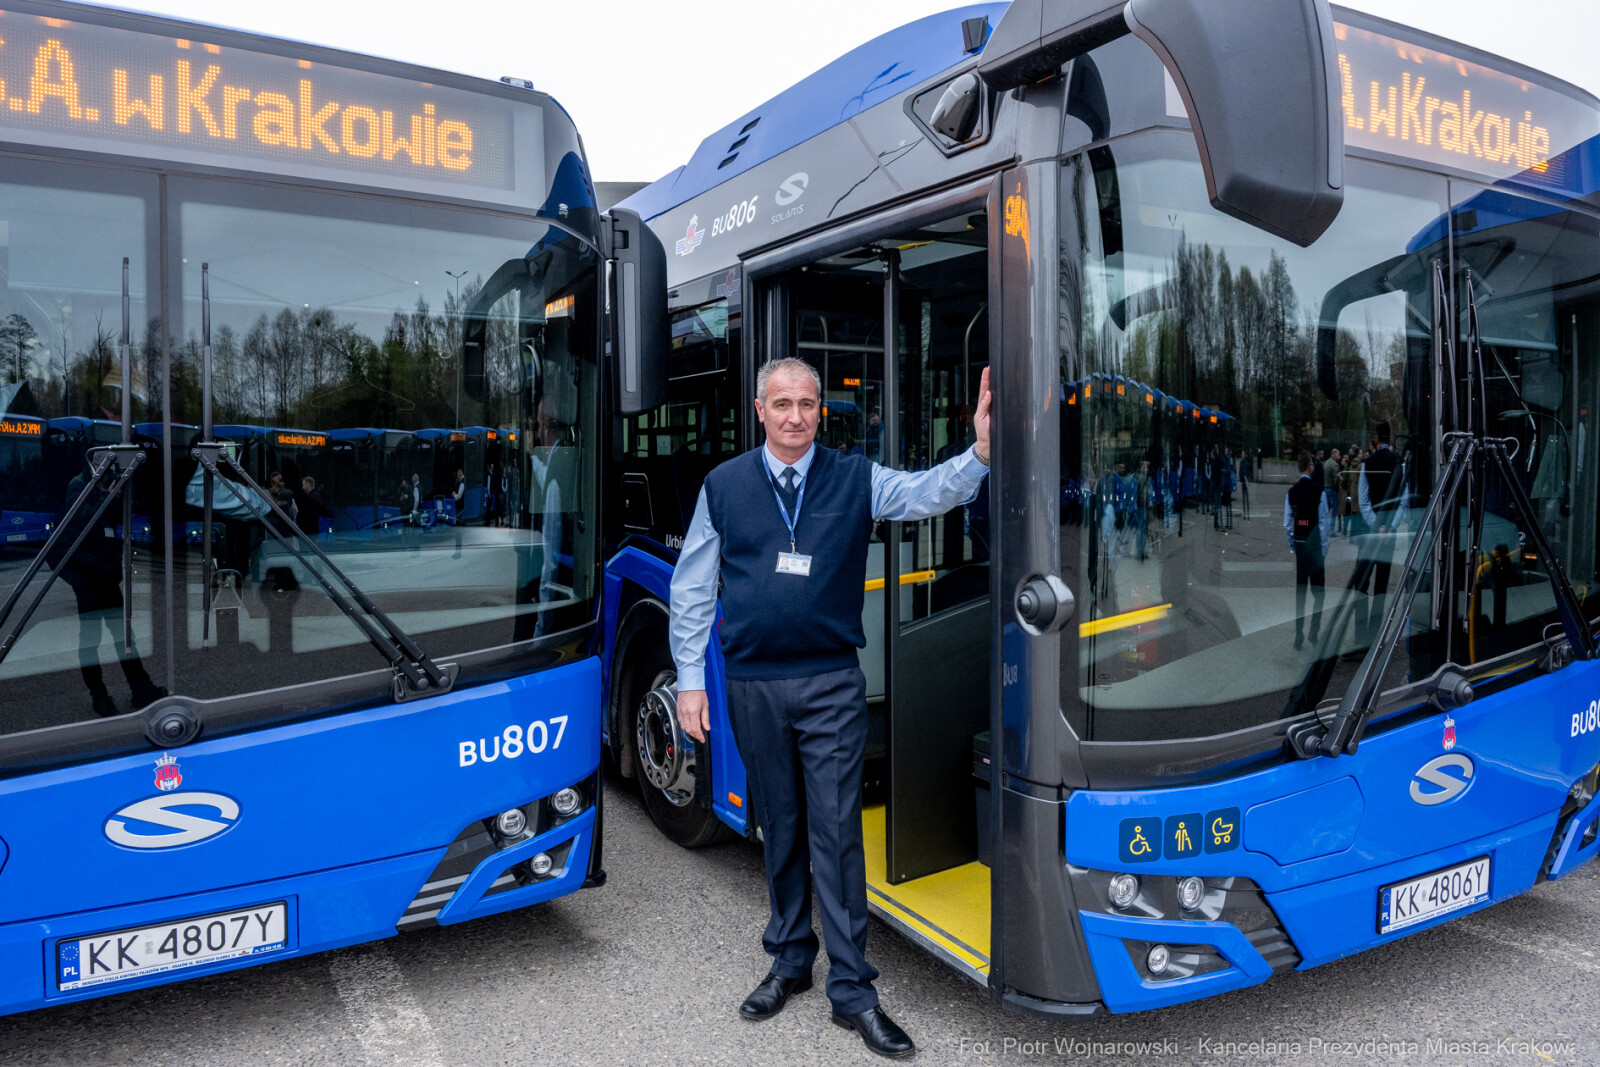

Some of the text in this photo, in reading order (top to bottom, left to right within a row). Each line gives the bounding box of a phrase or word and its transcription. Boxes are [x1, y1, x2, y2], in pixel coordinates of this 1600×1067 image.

[0, 37, 473, 170] .A. w Krakowie
[1369, 80, 1397, 137] w
[1400, 72, 1550, 172] Krakowie
[711, 195, 759, 237] BU806
[770, 203, 805, 225] SOLARIS
[459, 715, 568, 767] BU807
[1382, 912, 1390, 920] PL
[1395, 883, 1420, 919] KK
[1429, 863, 1484, 907] 4806Y
[89, 910, 274, 974] KK 4807Y
[63, 966, 78, 977] PL
